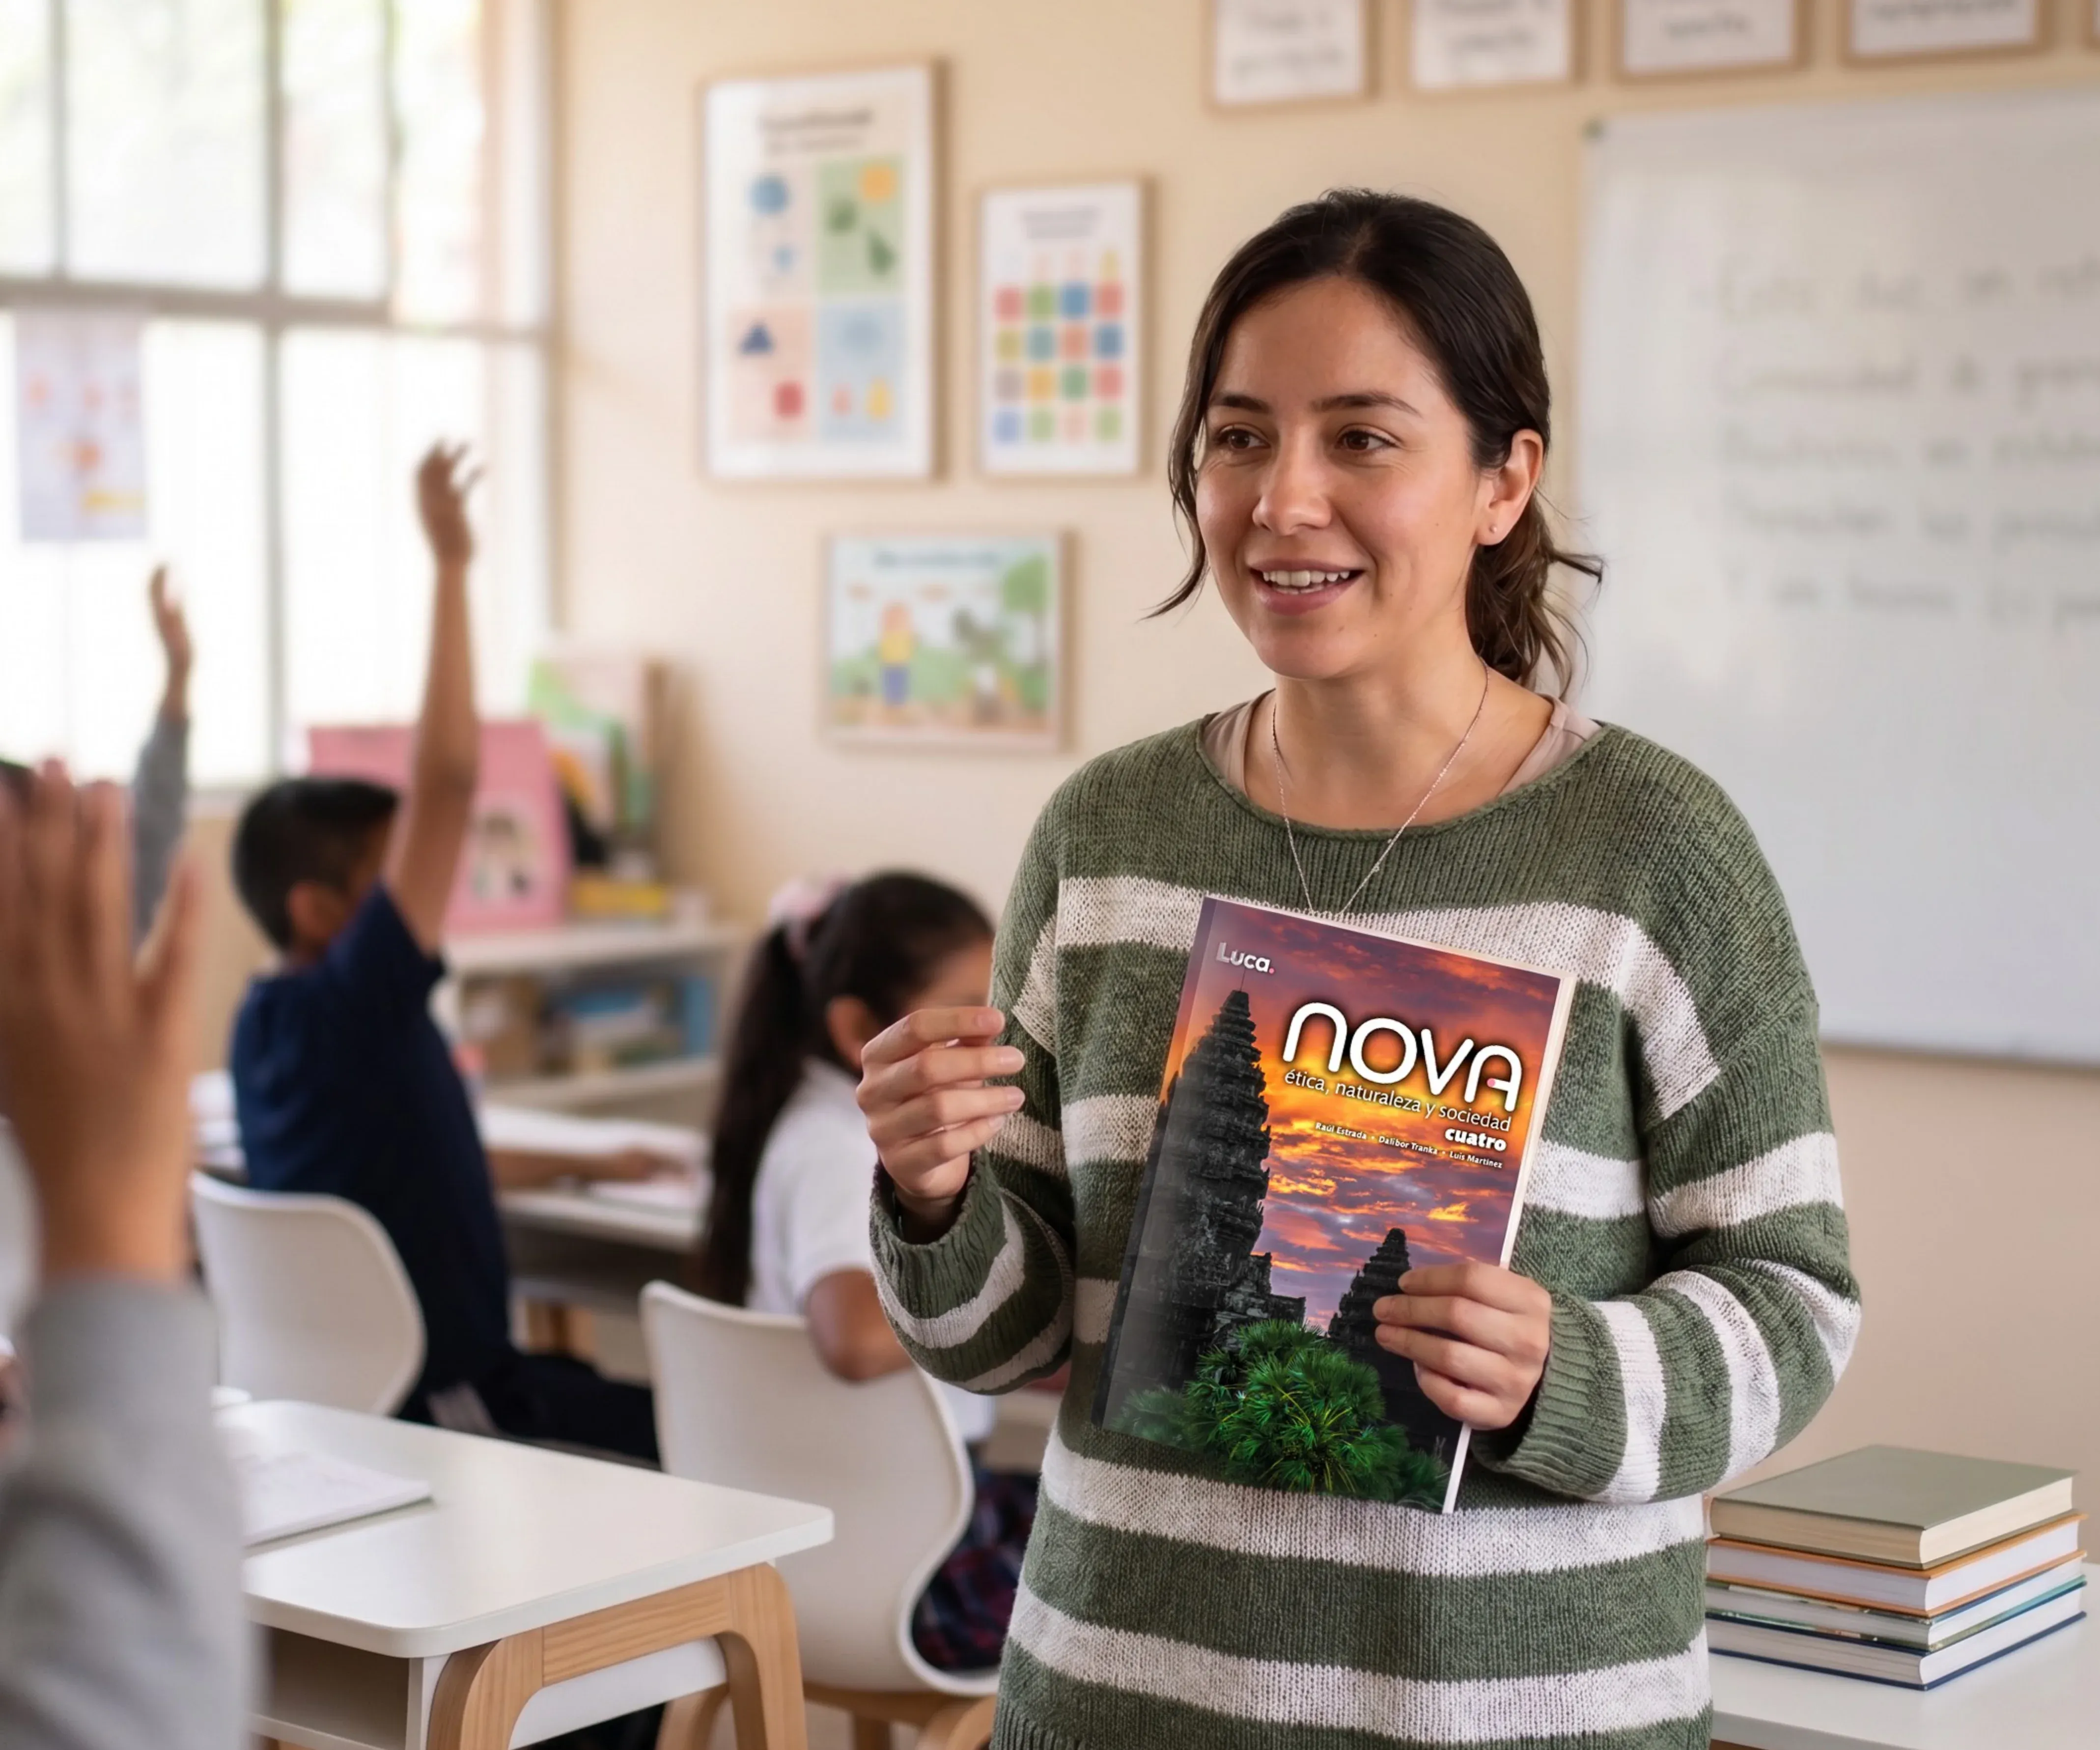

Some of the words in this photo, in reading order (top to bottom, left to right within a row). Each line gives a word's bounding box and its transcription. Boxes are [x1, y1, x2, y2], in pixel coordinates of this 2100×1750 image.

[1216, 942, 1275, 974] Luca.
[1285, 1069, 1329, 1096] ética,
[1335, 1082, 1421, 1112] naturaleza
[1425, 1102, 1436, 1119] y
[1438, 1105, 1512, 1132] sociedad
[1316, 1122, 1334, 1133] Raúl
[1336, 1127, 1367, 1139] Estrada
[1378, 1136, 1410, 1149] Dalibor
[1411, 1142, 1438, 1155] Tranka
[1449, 1151, 1465, 1160] Luis
[1445, 1128, 1508, 1152] cuatro
